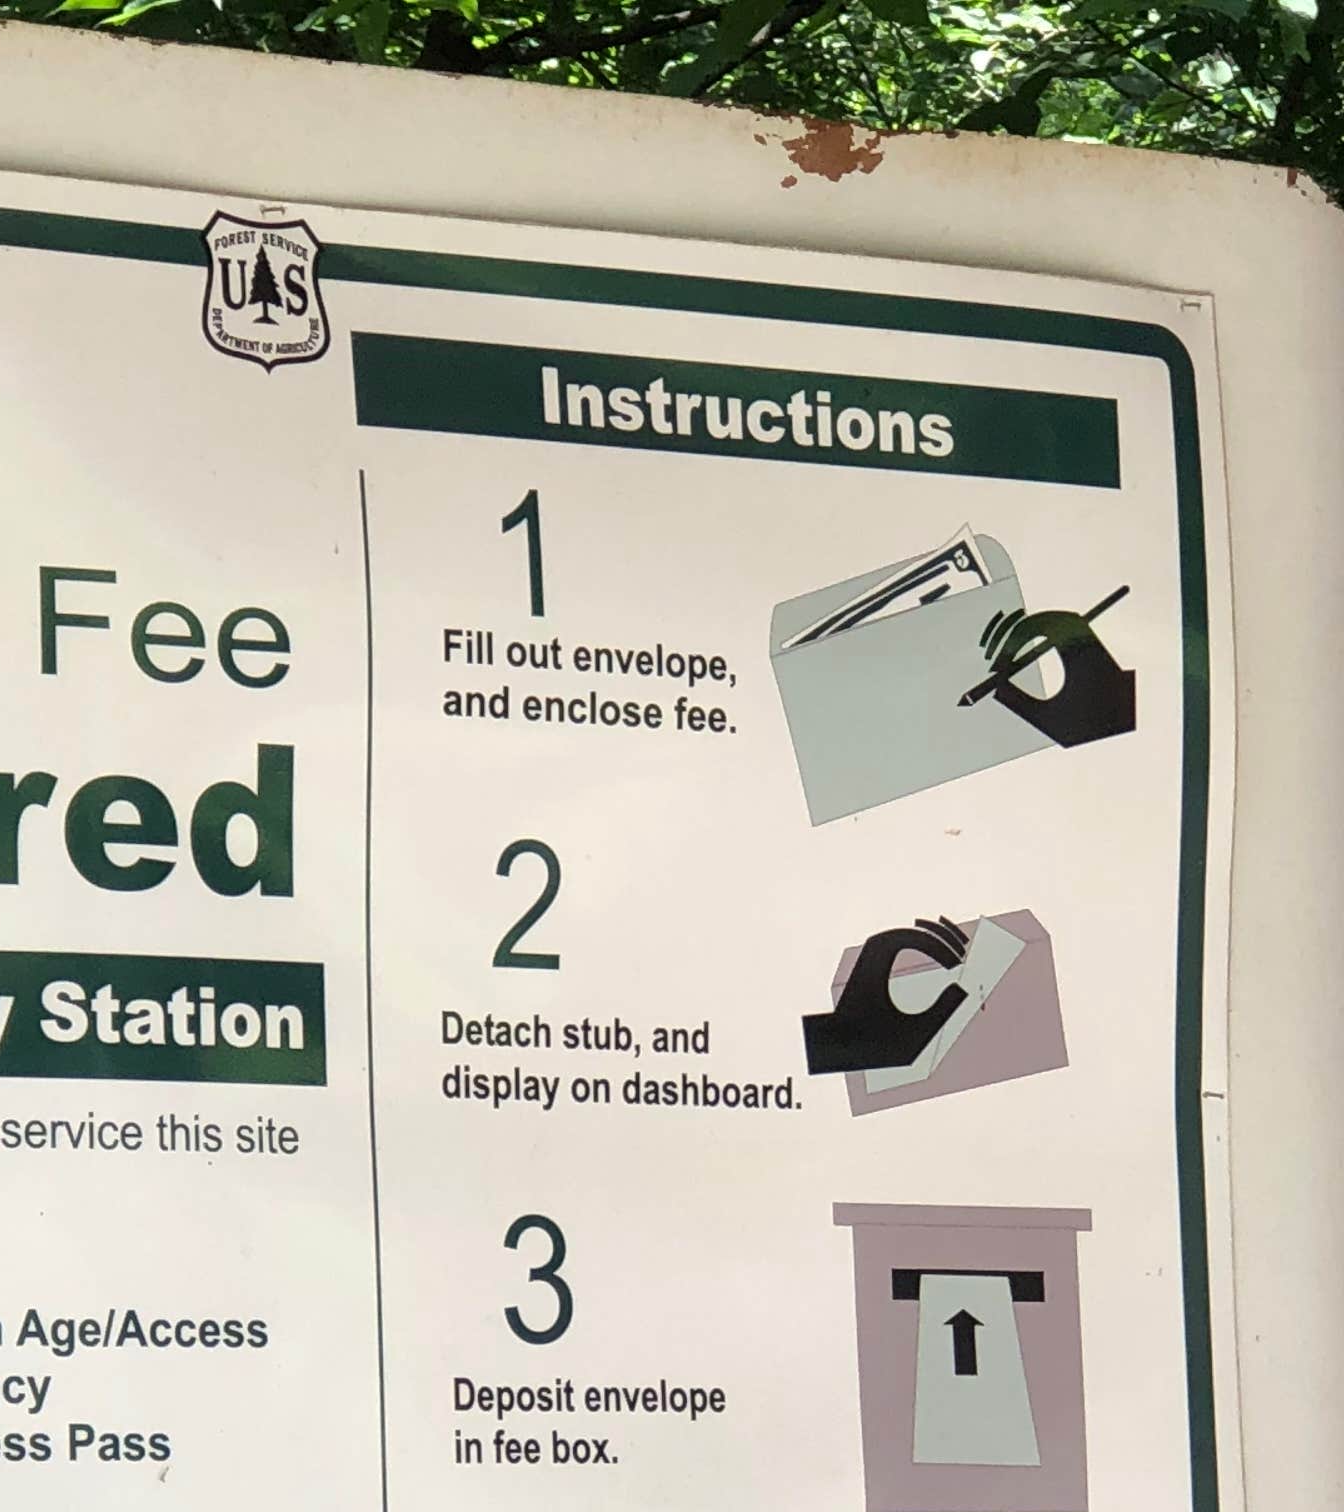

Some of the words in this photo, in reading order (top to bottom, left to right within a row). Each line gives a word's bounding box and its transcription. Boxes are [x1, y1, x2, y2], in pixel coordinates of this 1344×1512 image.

[213, 230, 256, 252] FOREST
[262, 232, 310, 263] SERVICE
[211, 307, 261, 355] DEPARTMENT
[261, 341, 274, 355] OF
[275, 317, 320, 355] AGRICULTURE
[540, 365, 956, 459] Instructions
[500, 487, 547, 619] 1
[38, 564, 293, 689] Fee
[442, 629, 494, 667] Fill
[506, 637, 564, 672] out
[572, 641, 738, 690] envelope,
[442, 686, 510, 721] and
[522, 689, 664, 730] enclose
[674, 697, 738, 735] fee.
[492, 837, 562, 972] 2
[40, 979, 306, 1052] Station
[440, 1010, 553, 1050] Detach
[561, 1017, 641, 1058] stub,
[652, 1021, 711, 1056] and
[441, 1063, 560, 1112] display
[570, 1073, 612, 1105] on
[621, 1072, 803, 1111] dashboard.
[0, 1112, 144, 1153] service
[156, 1113, 224, 1155] this
[234, 1115, 301, 1156] site
[502, 1212, 575, 1346] 3
[14, 1308, 269, 1356] Age/Access
[453, 1376, 576, 1421] Deposit
[584, 1380, 727, 1422] envelope
[67, 1424, 172, 1464] Pass
[453, 1430, 484, 1465] in
[492, 1430, 542, 1465] fee
[551, 1430, 620, 1465] box.
